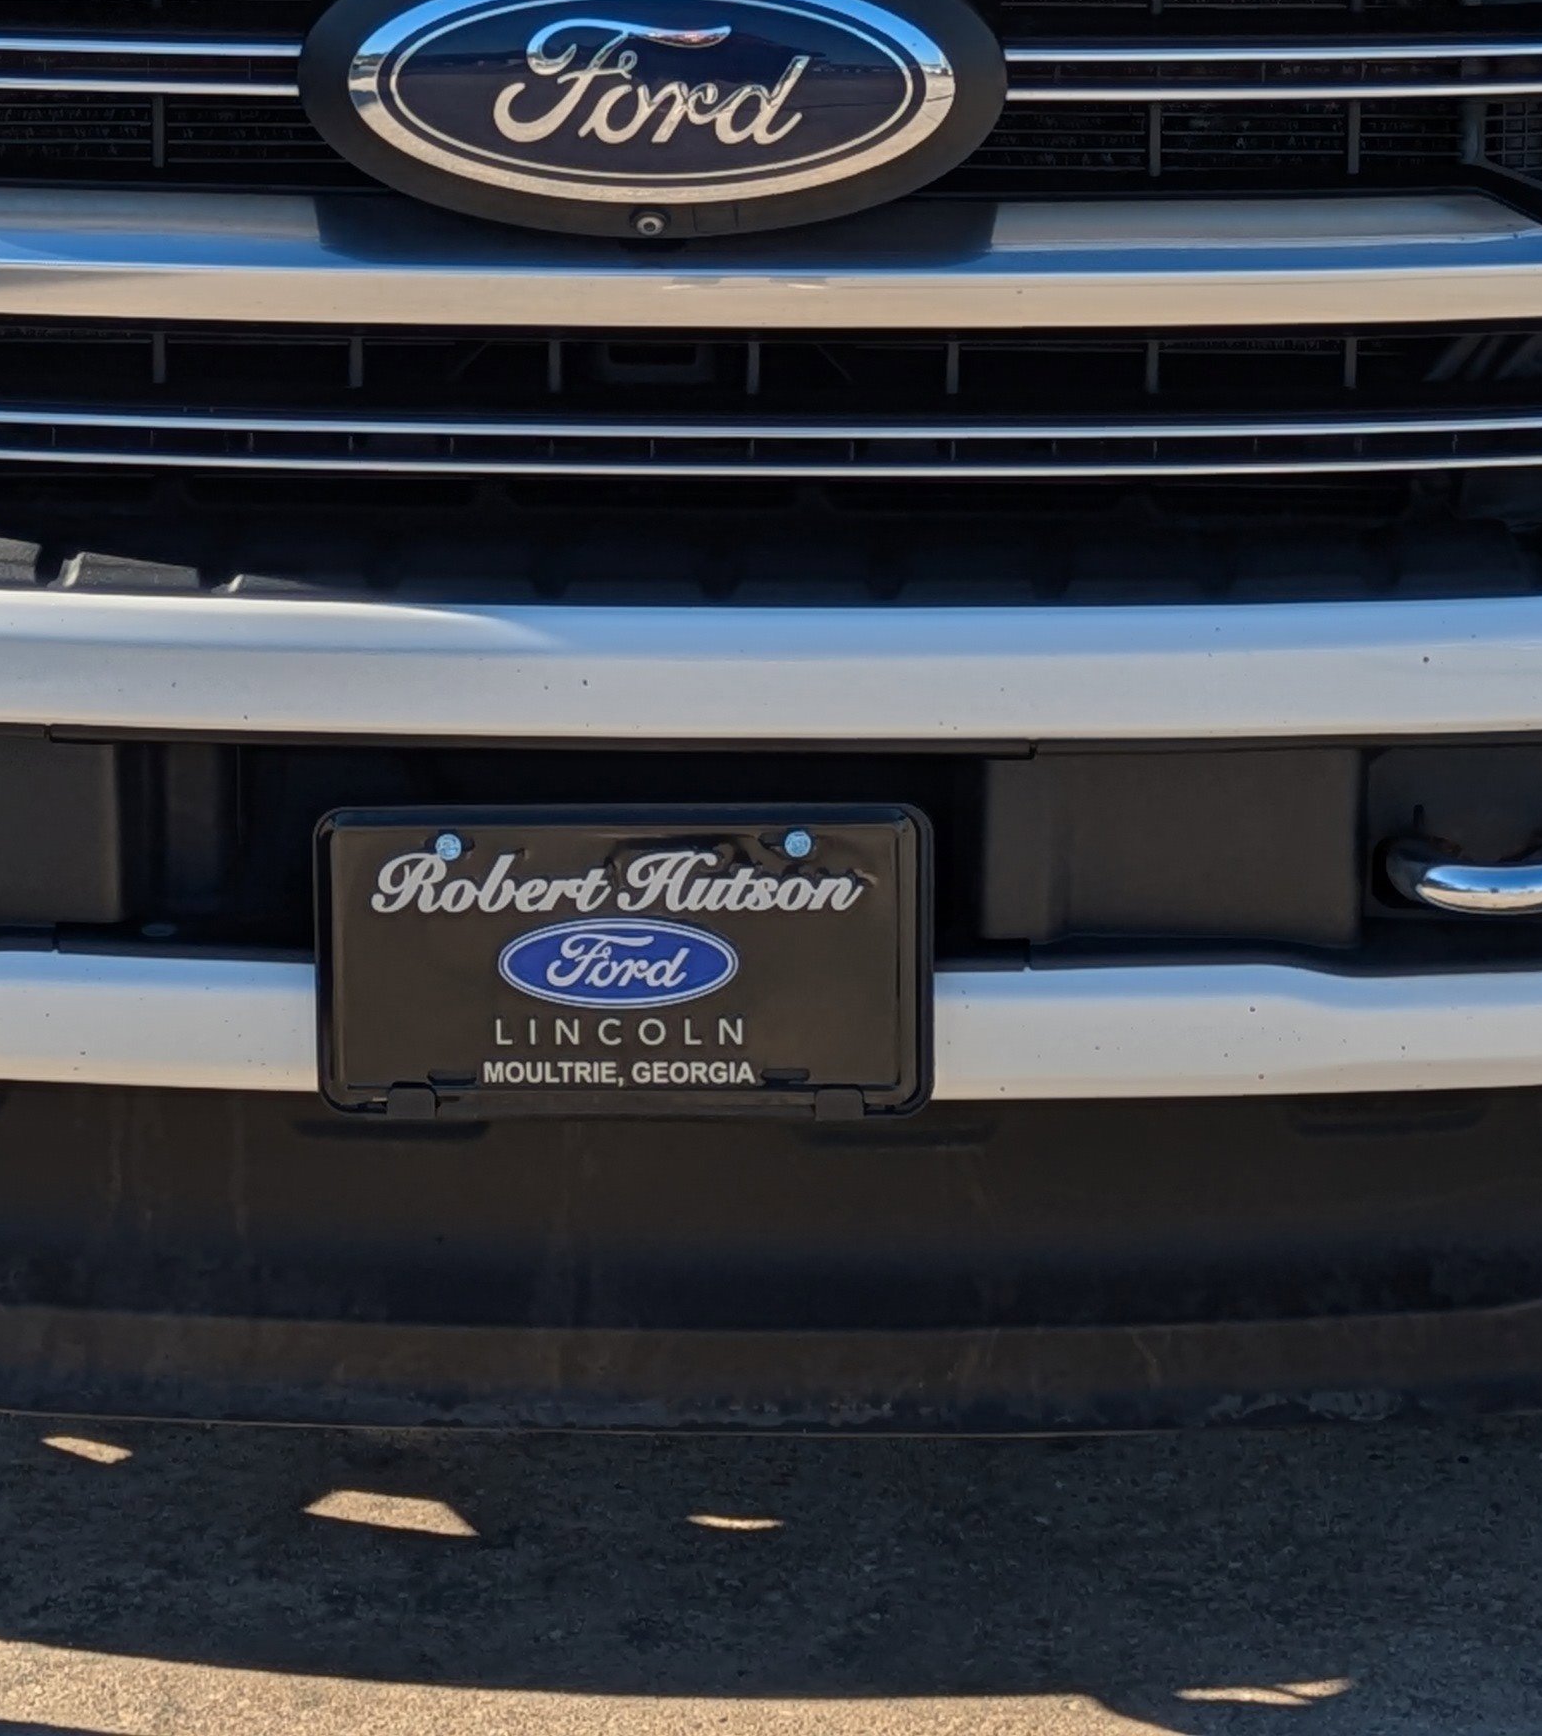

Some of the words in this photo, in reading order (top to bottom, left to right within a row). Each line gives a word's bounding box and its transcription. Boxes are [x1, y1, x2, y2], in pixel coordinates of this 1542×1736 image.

[493, 18, 811, 146] Ford
[370, 851, 612, 913] Robert
[616, 850, 864, 912] Hutson
[546, 932, 689, 988] Ford
[495, 1017, 745, 1046] LINCOLN
[482, 1061, 625, 1087] MOULTRIE,
[630, 1060, 757, 1085] GEORGIA
